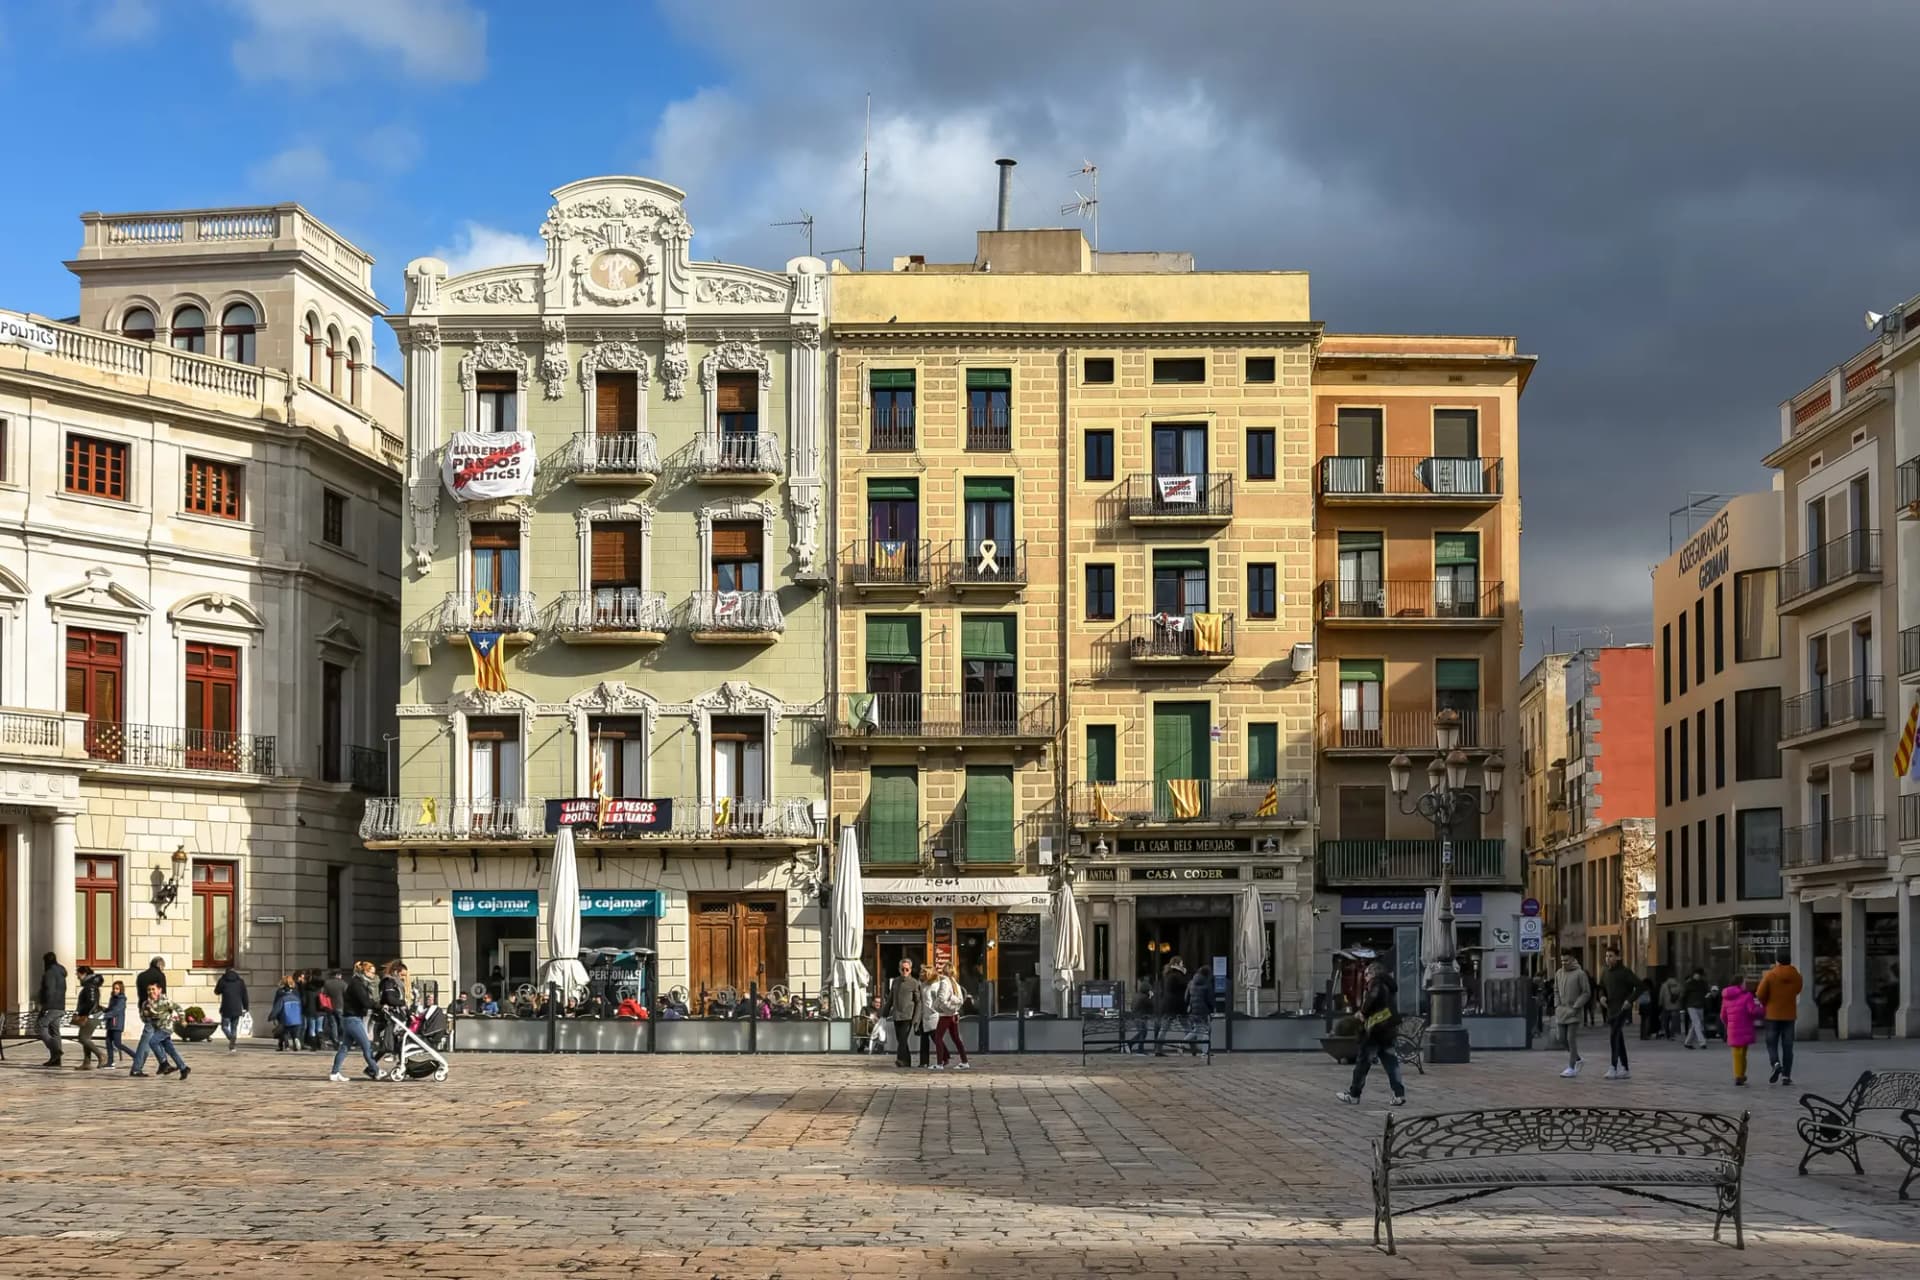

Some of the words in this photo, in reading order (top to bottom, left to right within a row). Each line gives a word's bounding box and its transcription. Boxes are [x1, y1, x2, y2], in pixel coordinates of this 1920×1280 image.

[1, 321, 54, 345] POLITICS
[1679, 511, 1729, 578] ASSEGURANCES
[615, 801, 654, 812] PRESOS
[1134, 840, 1145, 851] LA
[1149, 840, 1170, 851] CASA
[1146, 869, 1177, 879] CASA
[1184, 869, 1223, 879] CODER
[477, 896, 530, 912] cajamar
[595, 896, 648, 911] cajamar
[1031, 896, 1047, 904] Bar
[1362, 900, 1378, 910] La
[1382, 900, 1423, 910] Caseta
